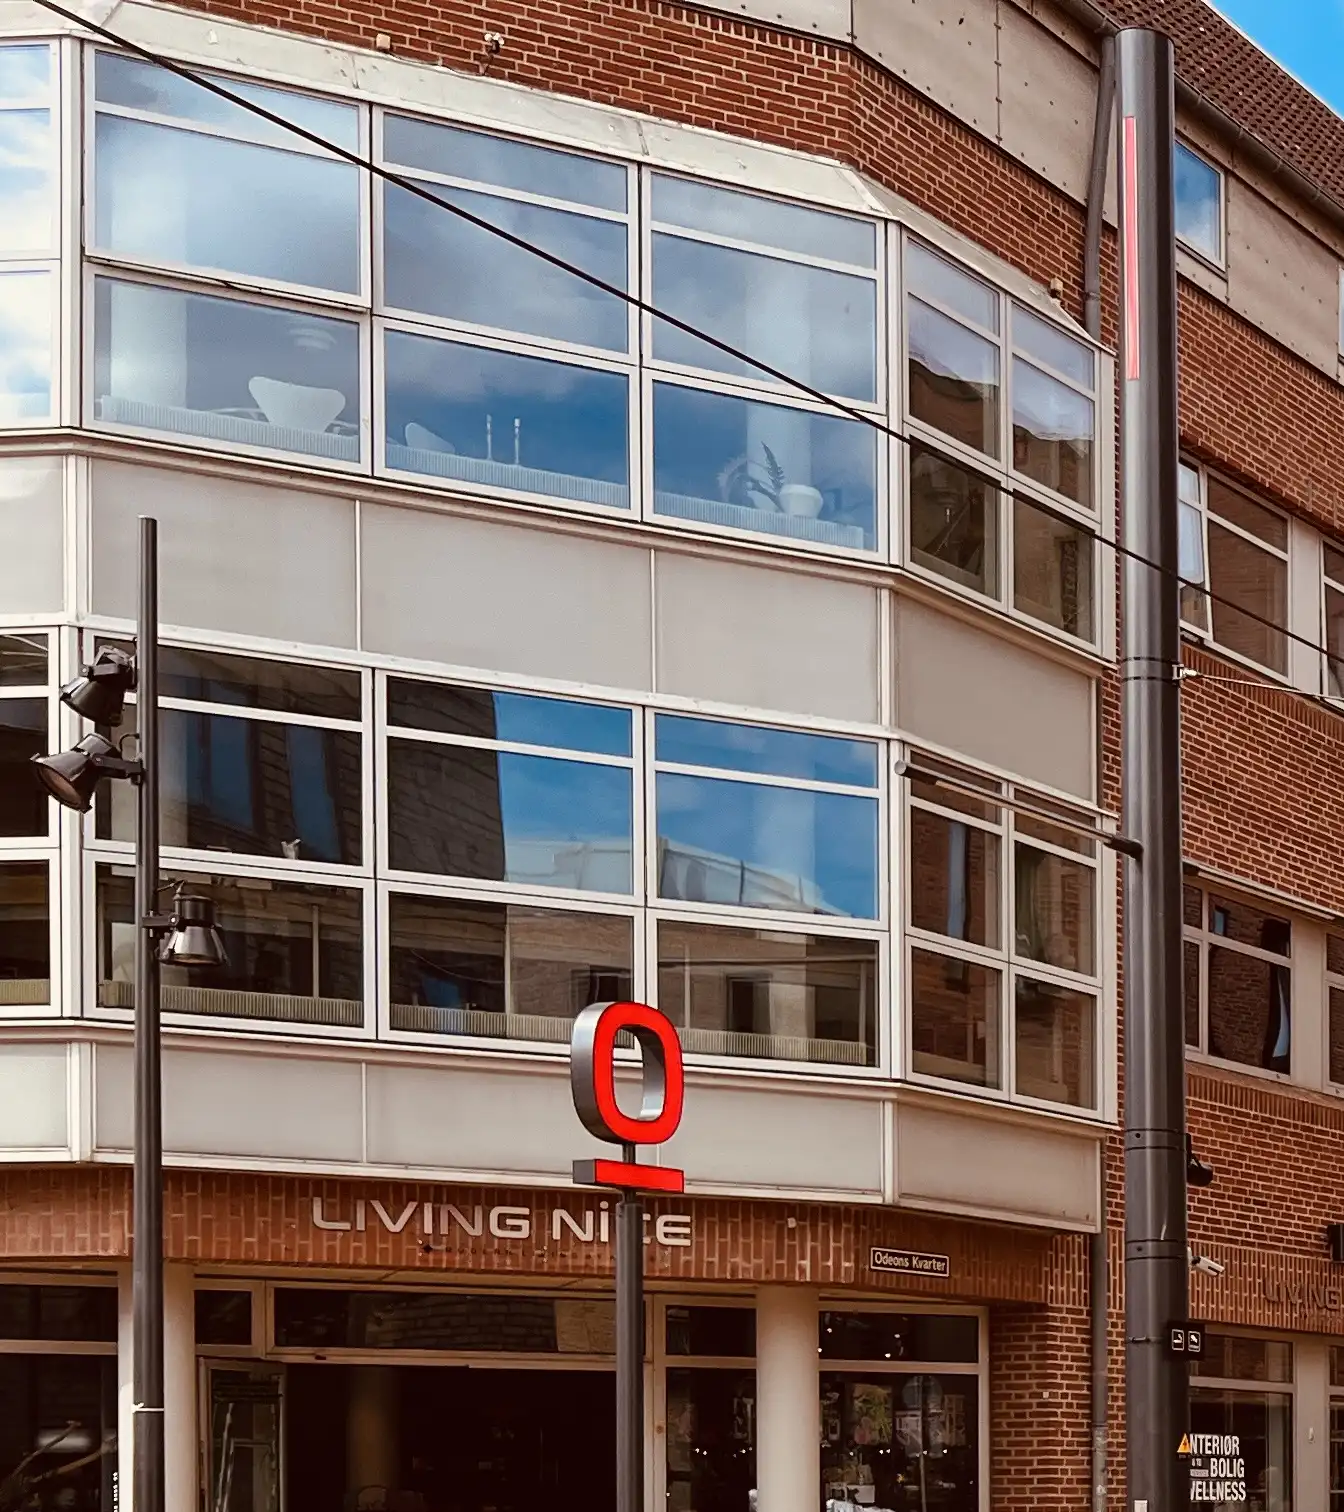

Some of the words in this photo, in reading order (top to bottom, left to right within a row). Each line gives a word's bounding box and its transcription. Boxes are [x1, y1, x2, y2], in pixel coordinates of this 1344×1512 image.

[312, 1196, 531, 1240] LIVING
[552, 1200, 691, 1247] NiE
[874, 1251, 910, 1268] Odeons
[912, 1255, 946, 1271] Kvarter
[1190, 1434, 1240, 1456] NTERIØR
[1210, 1457, 1245, 1478] BOLIG
